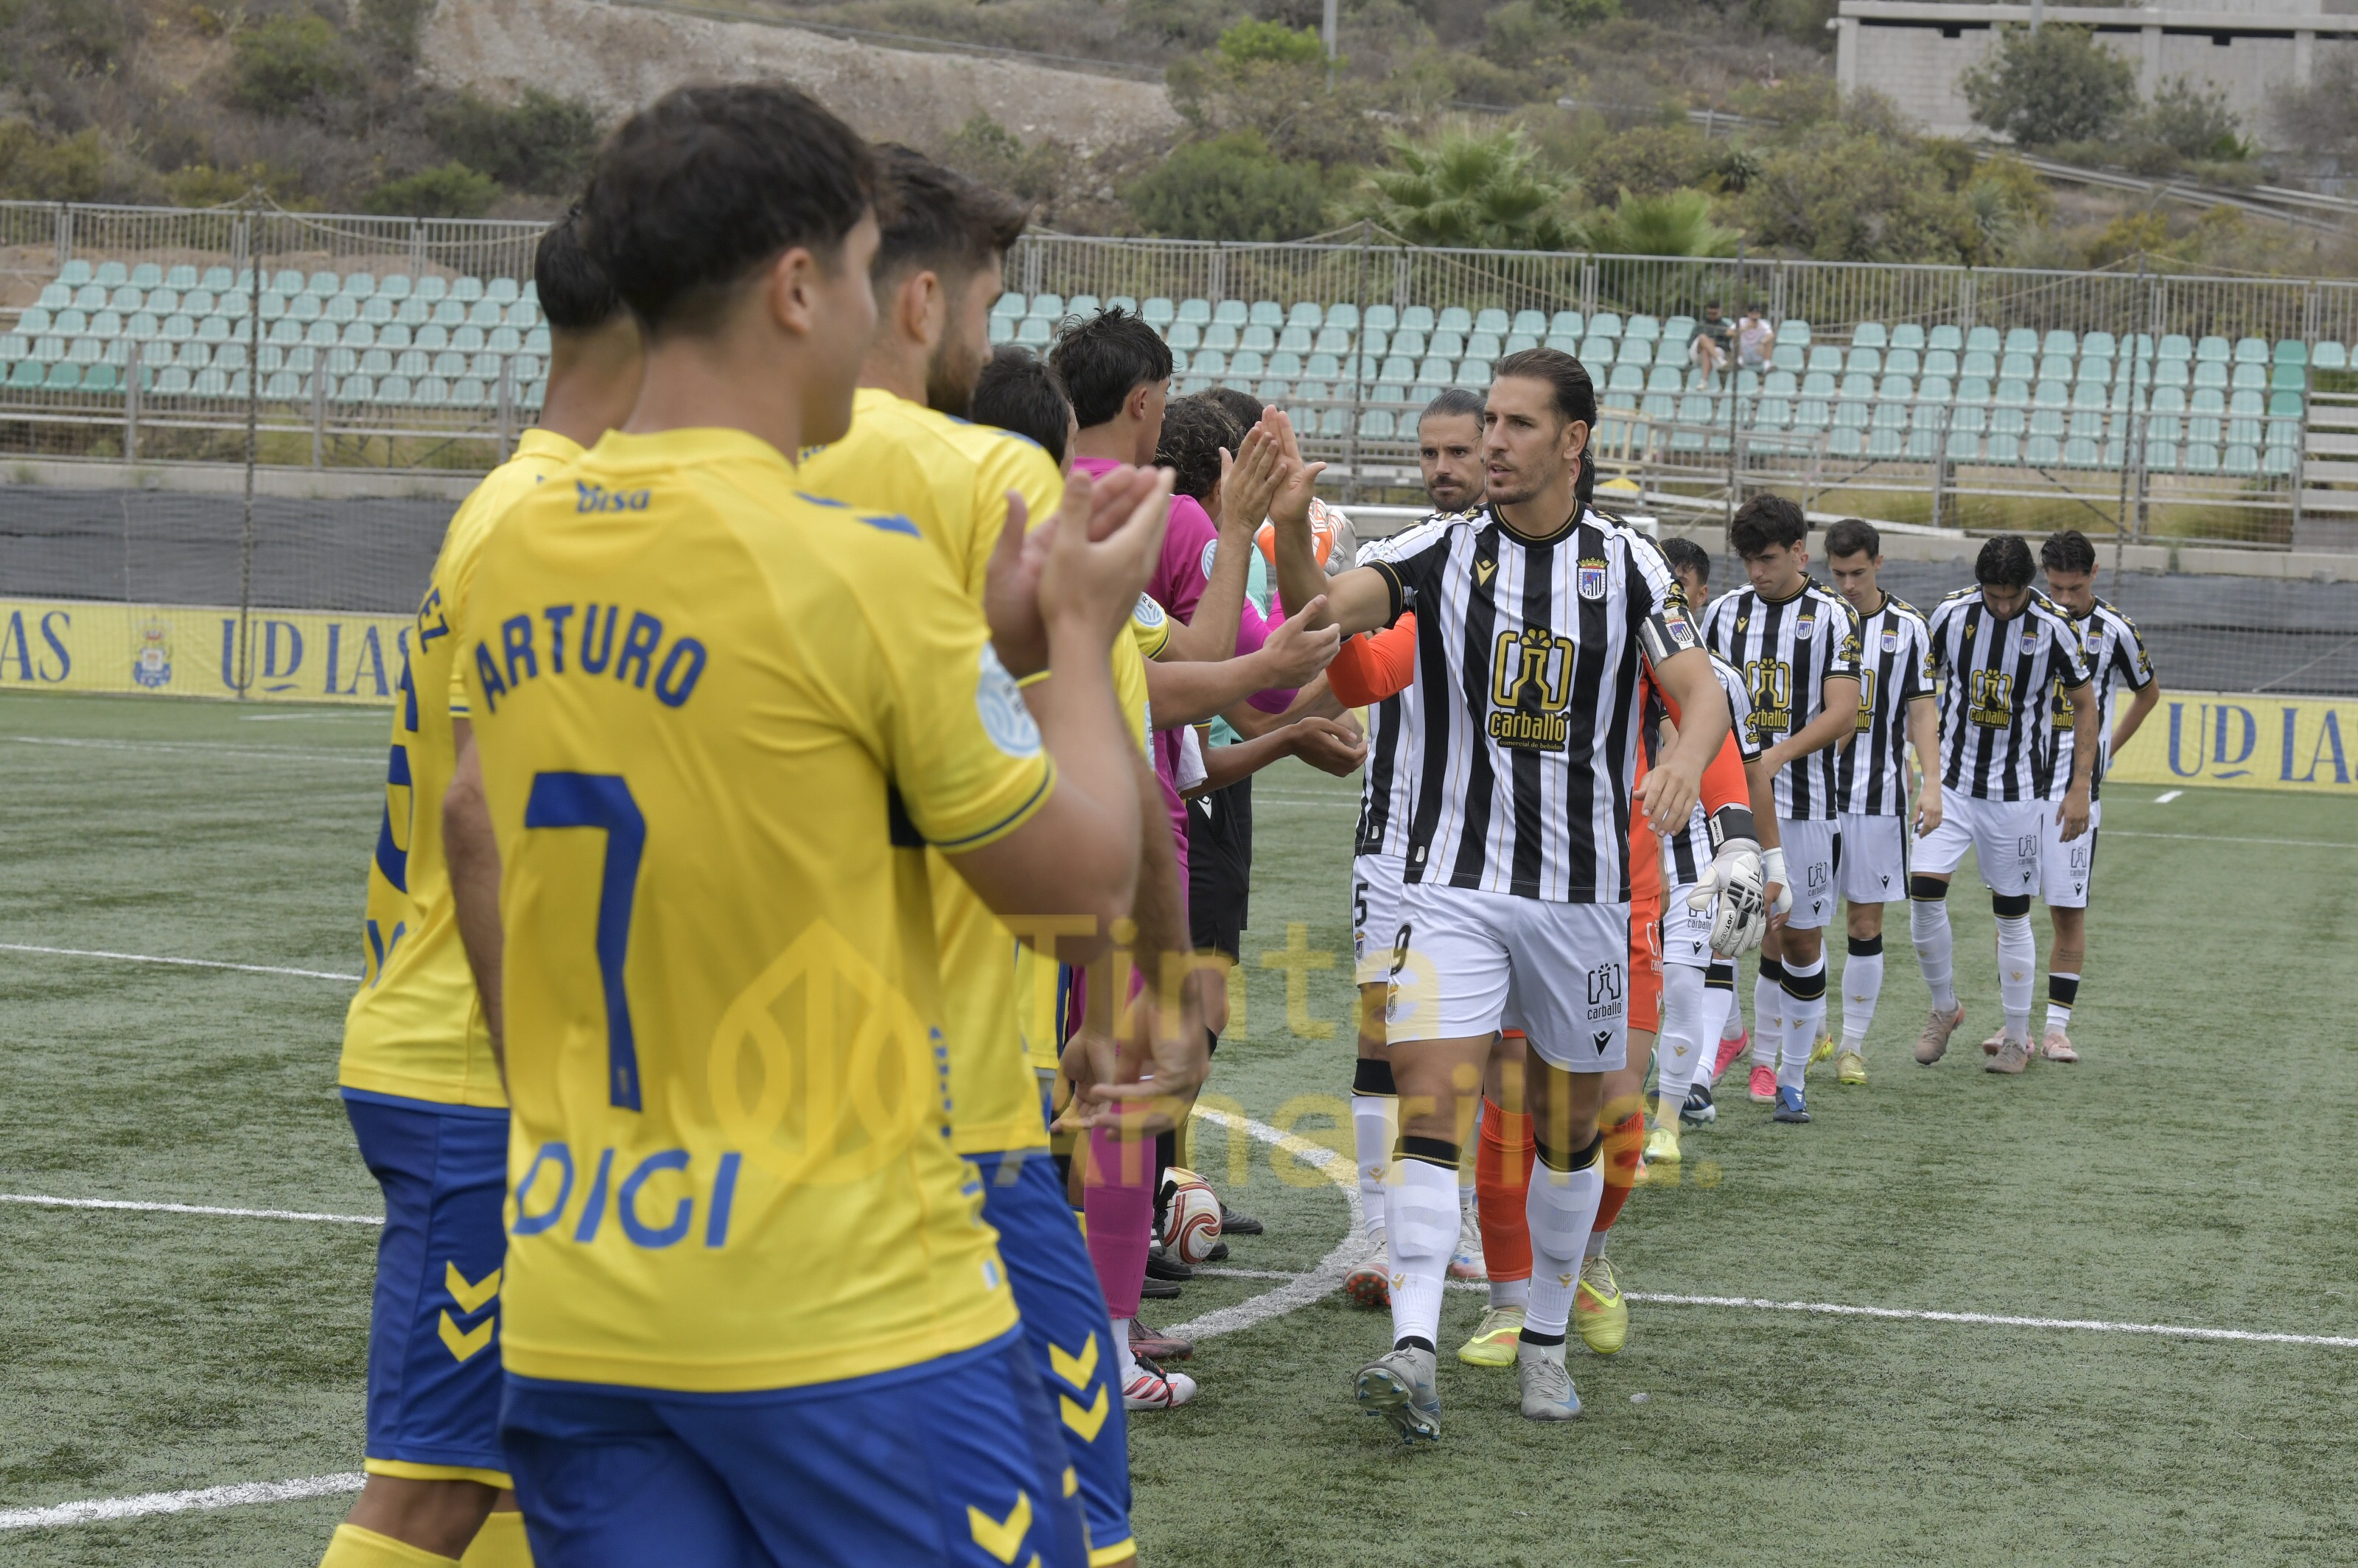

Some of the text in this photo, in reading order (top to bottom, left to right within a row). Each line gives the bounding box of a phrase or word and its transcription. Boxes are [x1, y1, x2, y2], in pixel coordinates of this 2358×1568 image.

[220, 618, 304, 692] UD
[475, 603, 708, 714] ARTURO
[1490, 710, 1564, 742] carballo
[1970, 708, 2009, 726] carballo
[1500, 740, 1530, 748] comercial
[1539, 742, 1563, 750] bebidas
[2168, 702, 2358, 784] UD LA
[1354, 883, 1368, 928] 5
[524, 769, 647, 1114] 7
[1390, 923, 1412, 977] 9
[1715, 914, 1733, 949] JOTAEFE
[1586, 1001, 1621, 1021] carballo
[511, 1141, 742, 1249] DIGI
